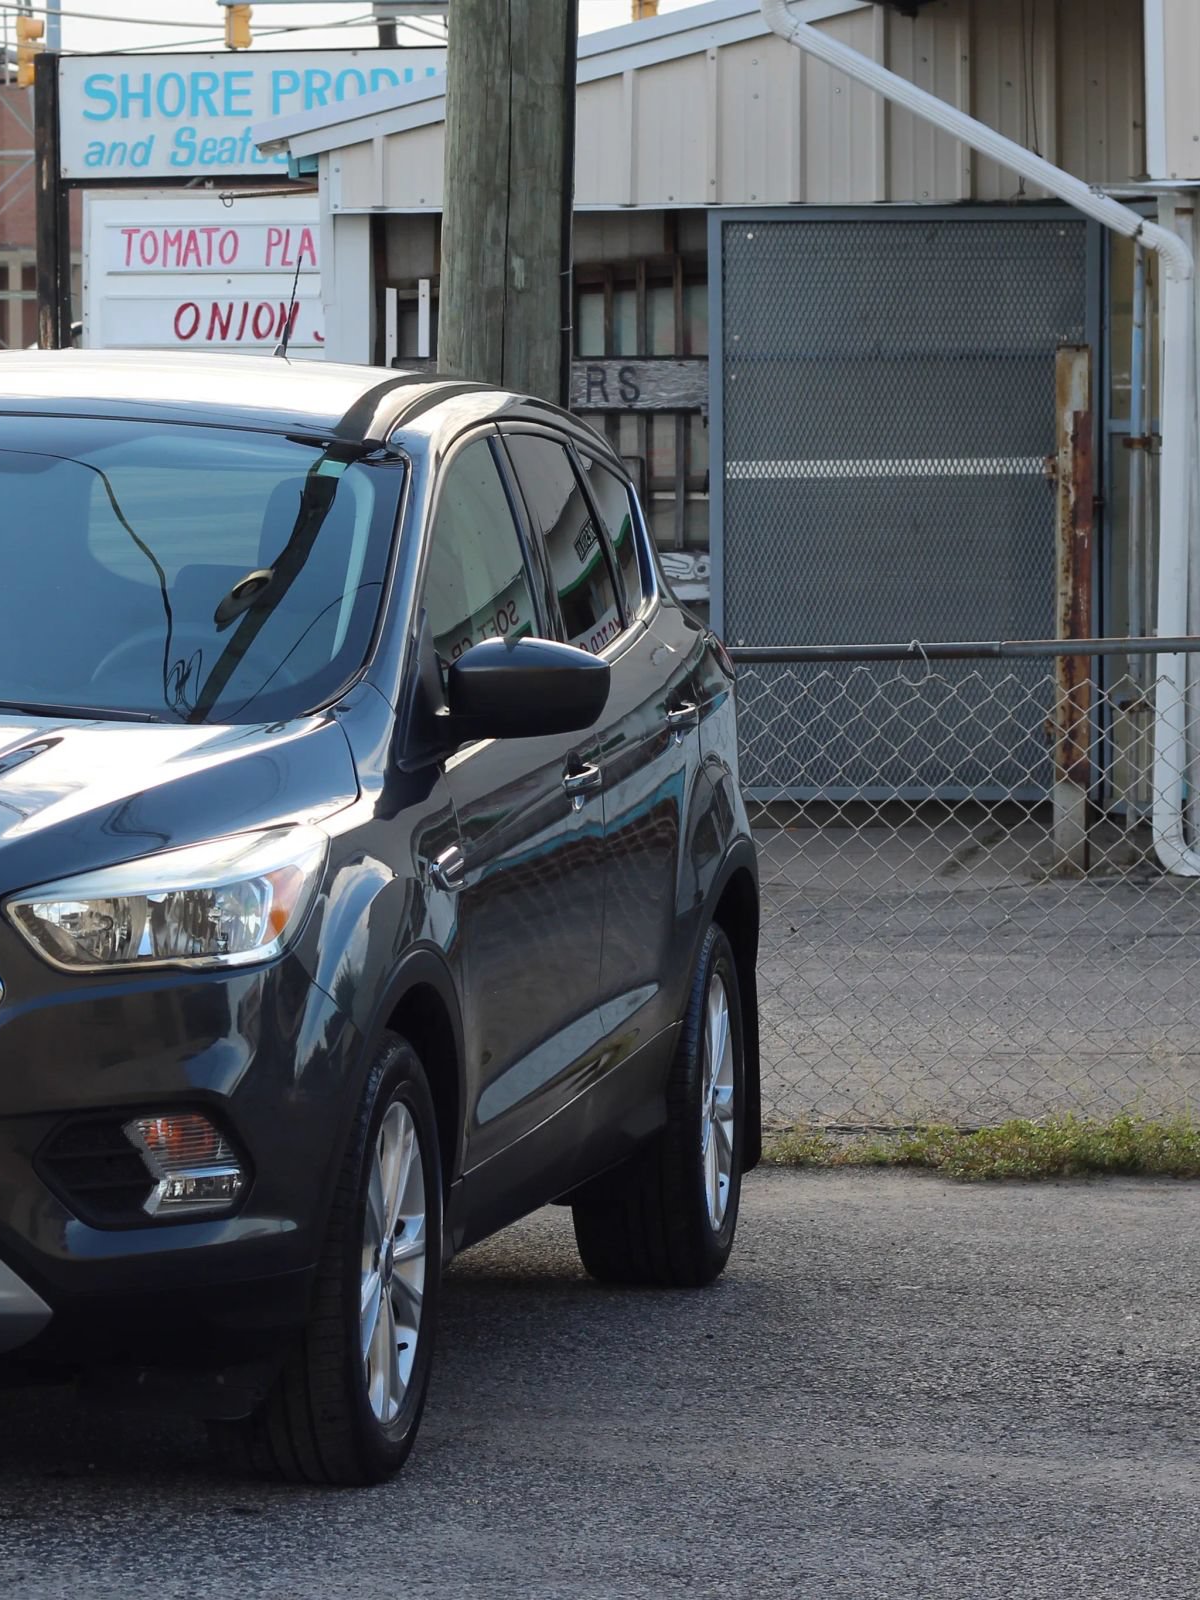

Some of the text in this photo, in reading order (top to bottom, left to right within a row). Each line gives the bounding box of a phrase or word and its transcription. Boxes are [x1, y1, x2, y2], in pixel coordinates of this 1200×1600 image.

[82, 71, 254, 122] SHORE
[84, 134, 156, 168] and
[121, 227, 239, 268] TOMATO
[174, 301, 300, 341] ONION
